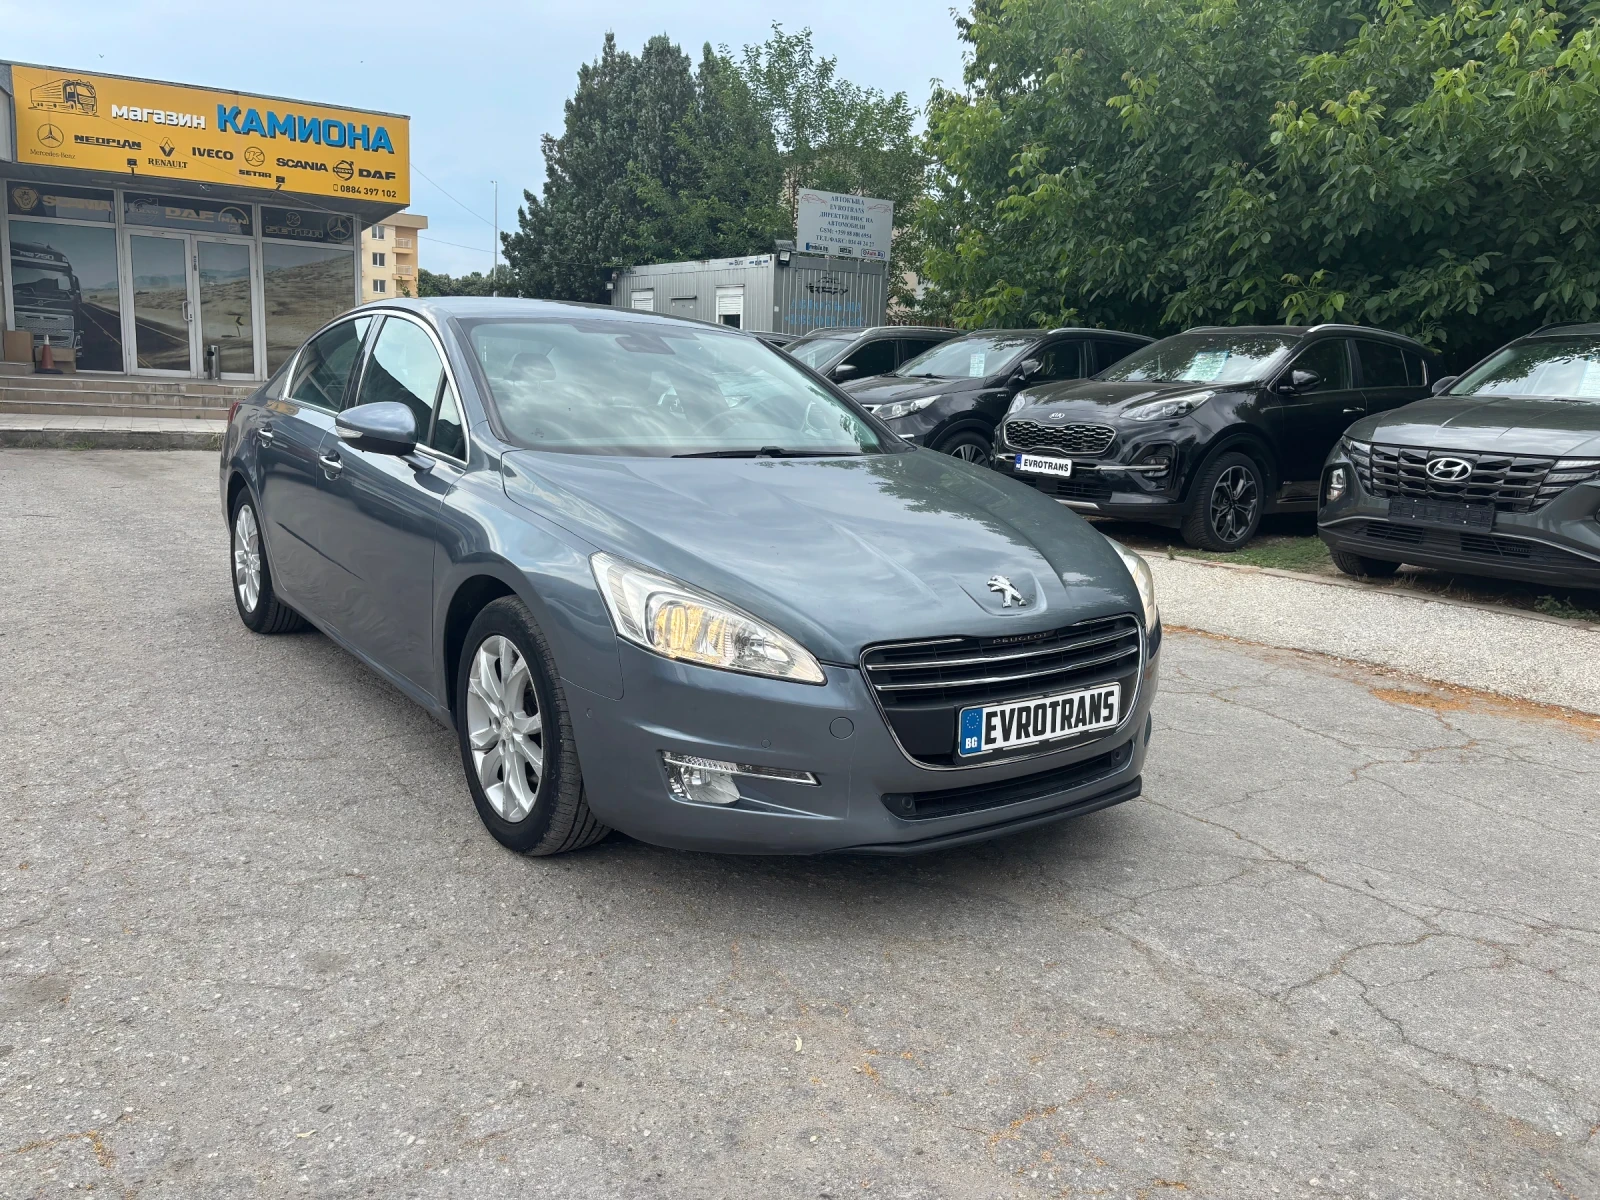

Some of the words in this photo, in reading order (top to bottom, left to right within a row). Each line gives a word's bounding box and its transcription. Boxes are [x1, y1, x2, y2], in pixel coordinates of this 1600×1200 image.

[111, 103, 206, 130] магазин
[217, 104, 394, 154] КАМИОНА
[74, 134, 142, 150] NEOPLAN
[30, 149, 76, 160] Mercedes-Benz
[192, 146, 234, 161] IVECO
[148, 158, 188, 169] RENAULT
[276, 157, 329, 173] SCANIA
[238, 169, 272, 179] SETRA
[359, 168, 396, 181] DAF
[340, 184, 362, 195] 0884
[363, 187, 379, 197] 397
[381, 189, 397, 198] 102
[165, 207, 216, 220] DAF
[221, 217, 247, 225] MAN
[265, 225, 324, 240] SETRA
[35, 252, 55, 261] 750
[1024, 459, 1069, 472] EVROTRANS
[992, 631, 1049, 645] PEUGEOT
[984, 689, 1115, 746] EVROTRANS
[965, 736, 978, 749] BG
